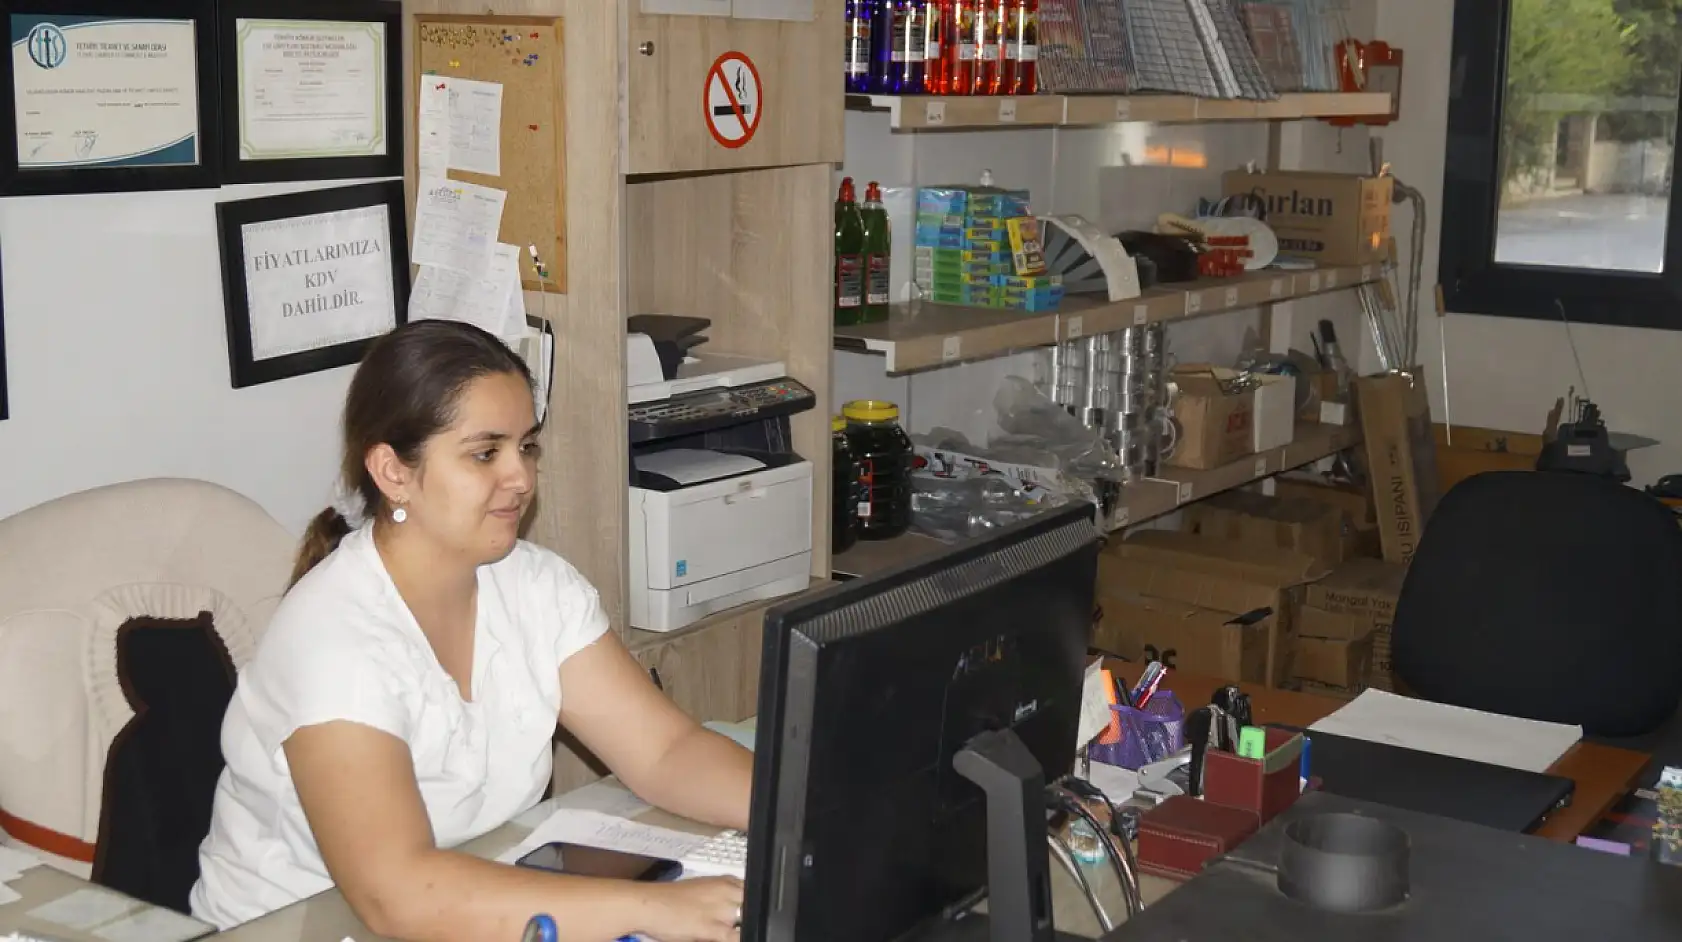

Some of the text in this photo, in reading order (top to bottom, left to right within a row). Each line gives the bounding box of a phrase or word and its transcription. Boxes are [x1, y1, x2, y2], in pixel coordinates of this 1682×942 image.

[253, 239, 380, 271] FİYATLARIMIZA
[304, 270, 338, 288] KDV
[282, 289, 363, 317] DAHİLDİR.
